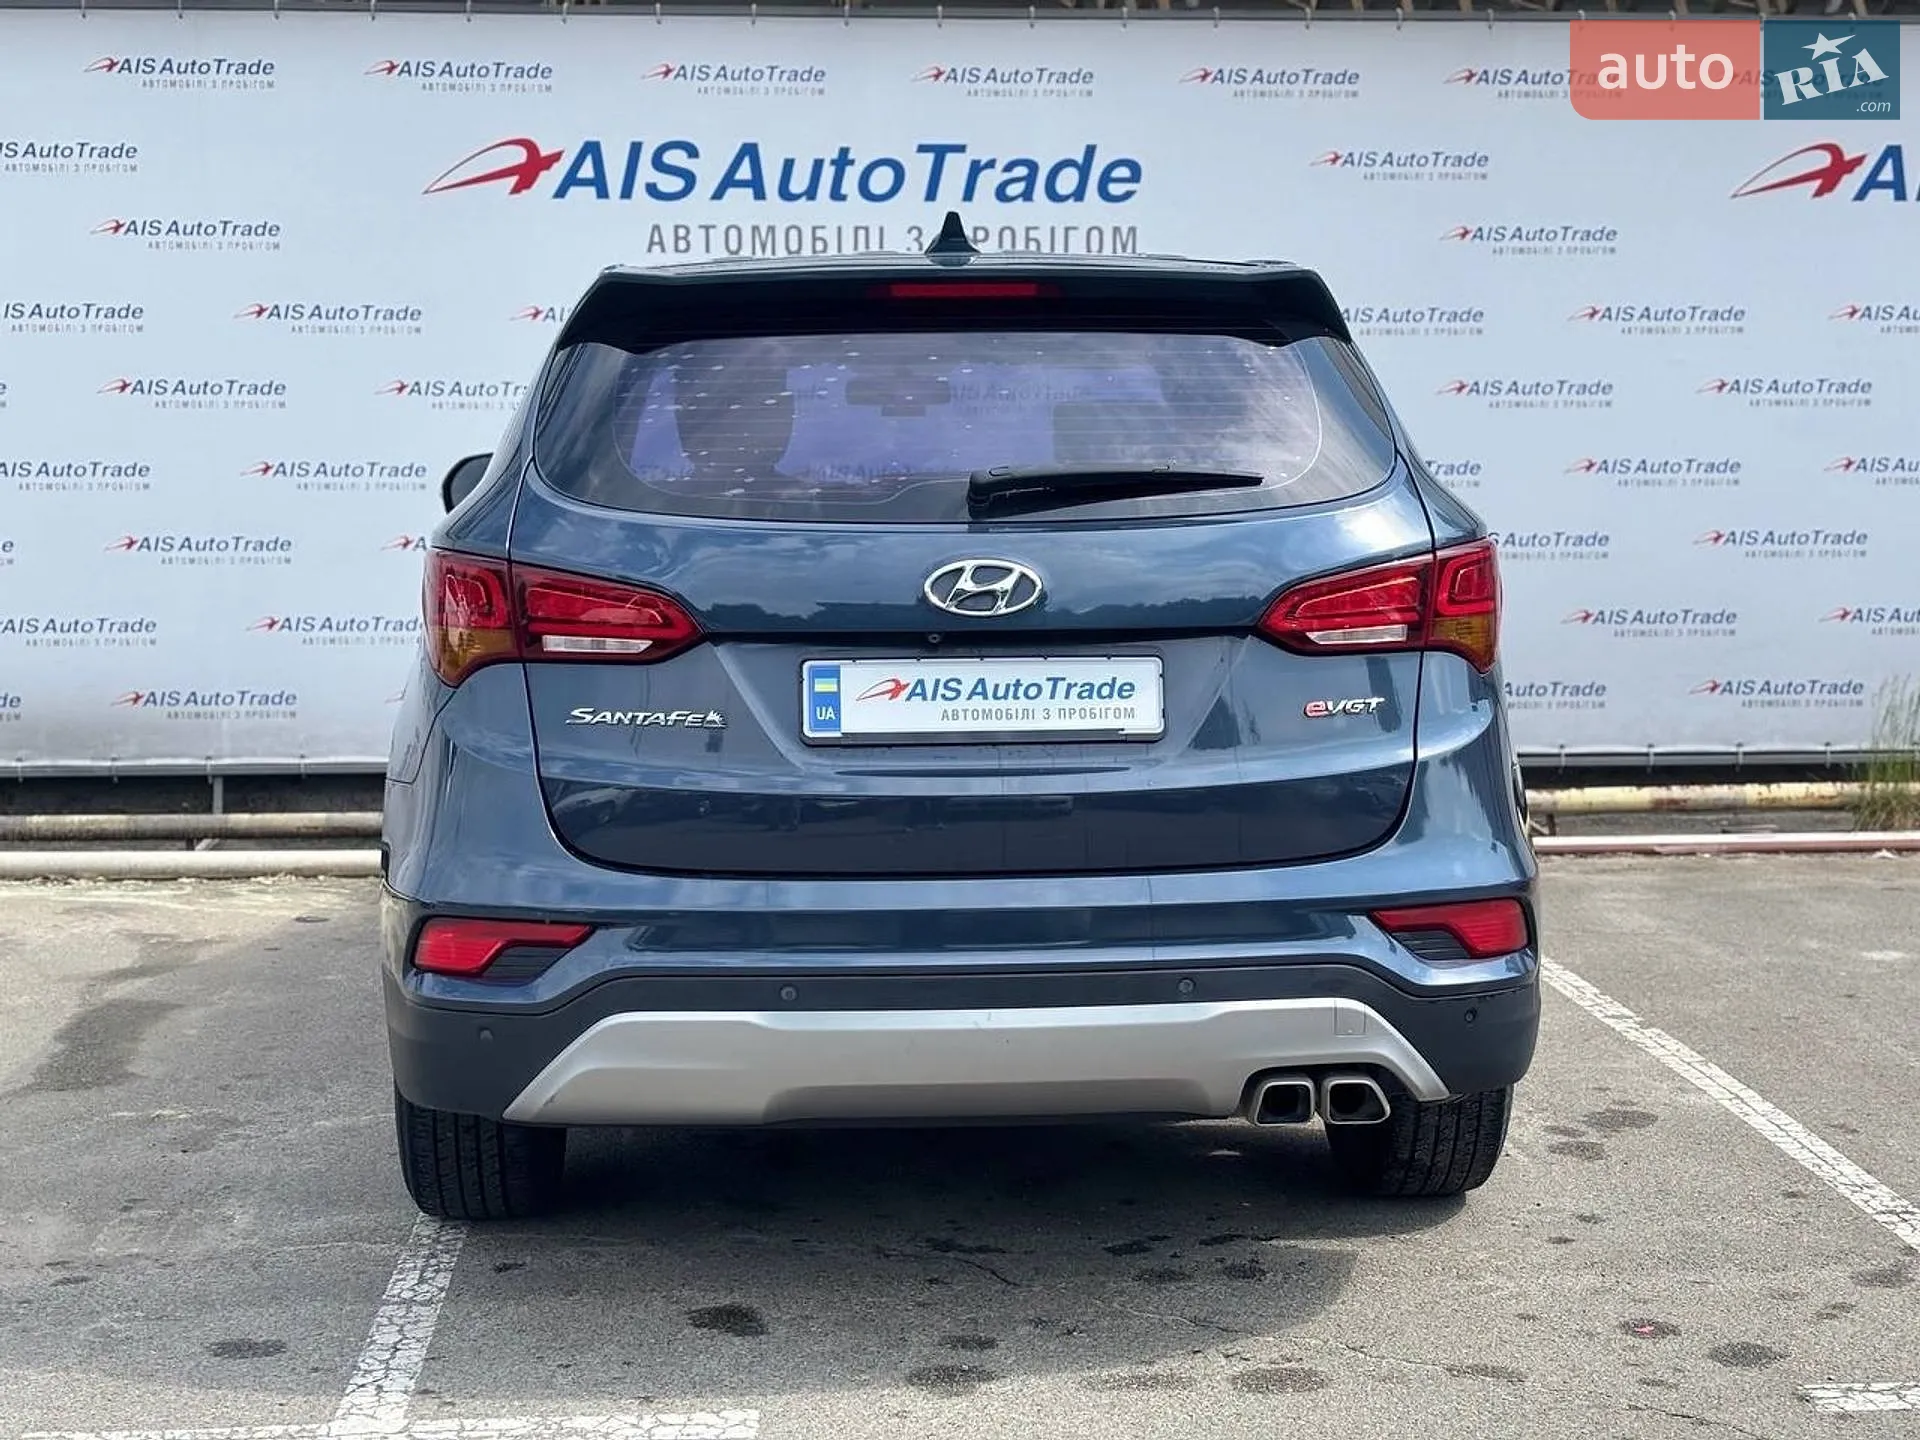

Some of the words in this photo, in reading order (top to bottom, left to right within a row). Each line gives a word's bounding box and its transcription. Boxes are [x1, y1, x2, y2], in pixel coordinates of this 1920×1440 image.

[119, 58, 157, 74] AIS
[161, 59, 274, 75] AutoTrade
[398, 61, 435, 77] AIS
[439, 62, 552, 79] AutoTrade
[674, 65, 711, 81] AIS
[715, 66, 826, 82] AutoTrade
[943, 67, 979, 84] AIS
[983, 68, 1093, 84] AutoTrade
[1212, 68, 1248, 85] AIS
[1251, 69, 1359, 85] AutoTrade
[1476, 69, 1511, 85] AIS
[23, 142, 138, 158] AutoTrade
[1343, 152, 1378, 167] AIS
[1382, 152, 1489, 167] AutoTrade
[552, 140, 698, 201] AIS
[711, 143, 1142, 203] AutoTrade
[125, 220, 163, 236] AIS
[167, 220, 280, 236] AutoTrade
[1472, 226, 1507, 242] AIS
[1511, 226, 1617, 241] AutoTrade
[646, 223, 886, 256] АВТОМОБІЛІ
[972, 225, 1139, 253] РОБІГОМ
[4, 303, 25, 319] IS
[30, 303, 144, 319] AutoTrade
[268, 304, 306, 320] AIS
[310, 305, 422, 321] AutoTrade
[1377, 308, 1484, 323] AutoTrade
[1601, 306, 1636, 322] AIS
[1640, 306, 1745, 321] AutoTrade
[1861, 305, 1896, 321] AIS
[131, 379, 169, 395] AIS
[173, 380, 286, 395] AutoTrade
[410, 380, 447, 397] AIS
[1468, 380, 1503, 396] AIS
[1507, 380, 1613, 395] AutoTrade
[1728, 379, 1763, 394] AIS
[1767, 379, 1872, 394] AutoTrade
[37, 462, 150, 477] AutoTrade
[274, 462, 311, 477] AIS
[315, 462, 427, 477] AutoTrade
[1596, 459, 1632, 474] AIS
[1635, 459, 1741, 474] AutoTrade
[1855, 457, 1890, 472] AIS
[138, 536, 175, 552] AIS
[179, 536, 292, 552] AutoTrade
[1503, 532, 1609, 547] AutoTrade
[1724, 530, 1759, 546] AIS
[1763, 530, 1868, 545] AutoTrade
[1592, 609, 1628, 625] AIS
[1631, 609, 1737, 624] AutoTrade
[1851, 608, 1886, 623] AIS
[3, 618, 40, 634] AIS
[44, 618, 157, 633] AutoTrade
[278, 617, 316, 632] AIS
[320, 617, 422, 632] AutoTrad
[905, 678, 962, 702] AIS
[967, 676, 1135, 702] AutoTrade
[1721, 680, 1756, 695] AIS
[1759, 680, 1864, 695] AutoTrade
[144, 691, 181, 706] AIS
[185, 691, 297, 706] AutoTrade
[816, 707, 836, 721] UA
